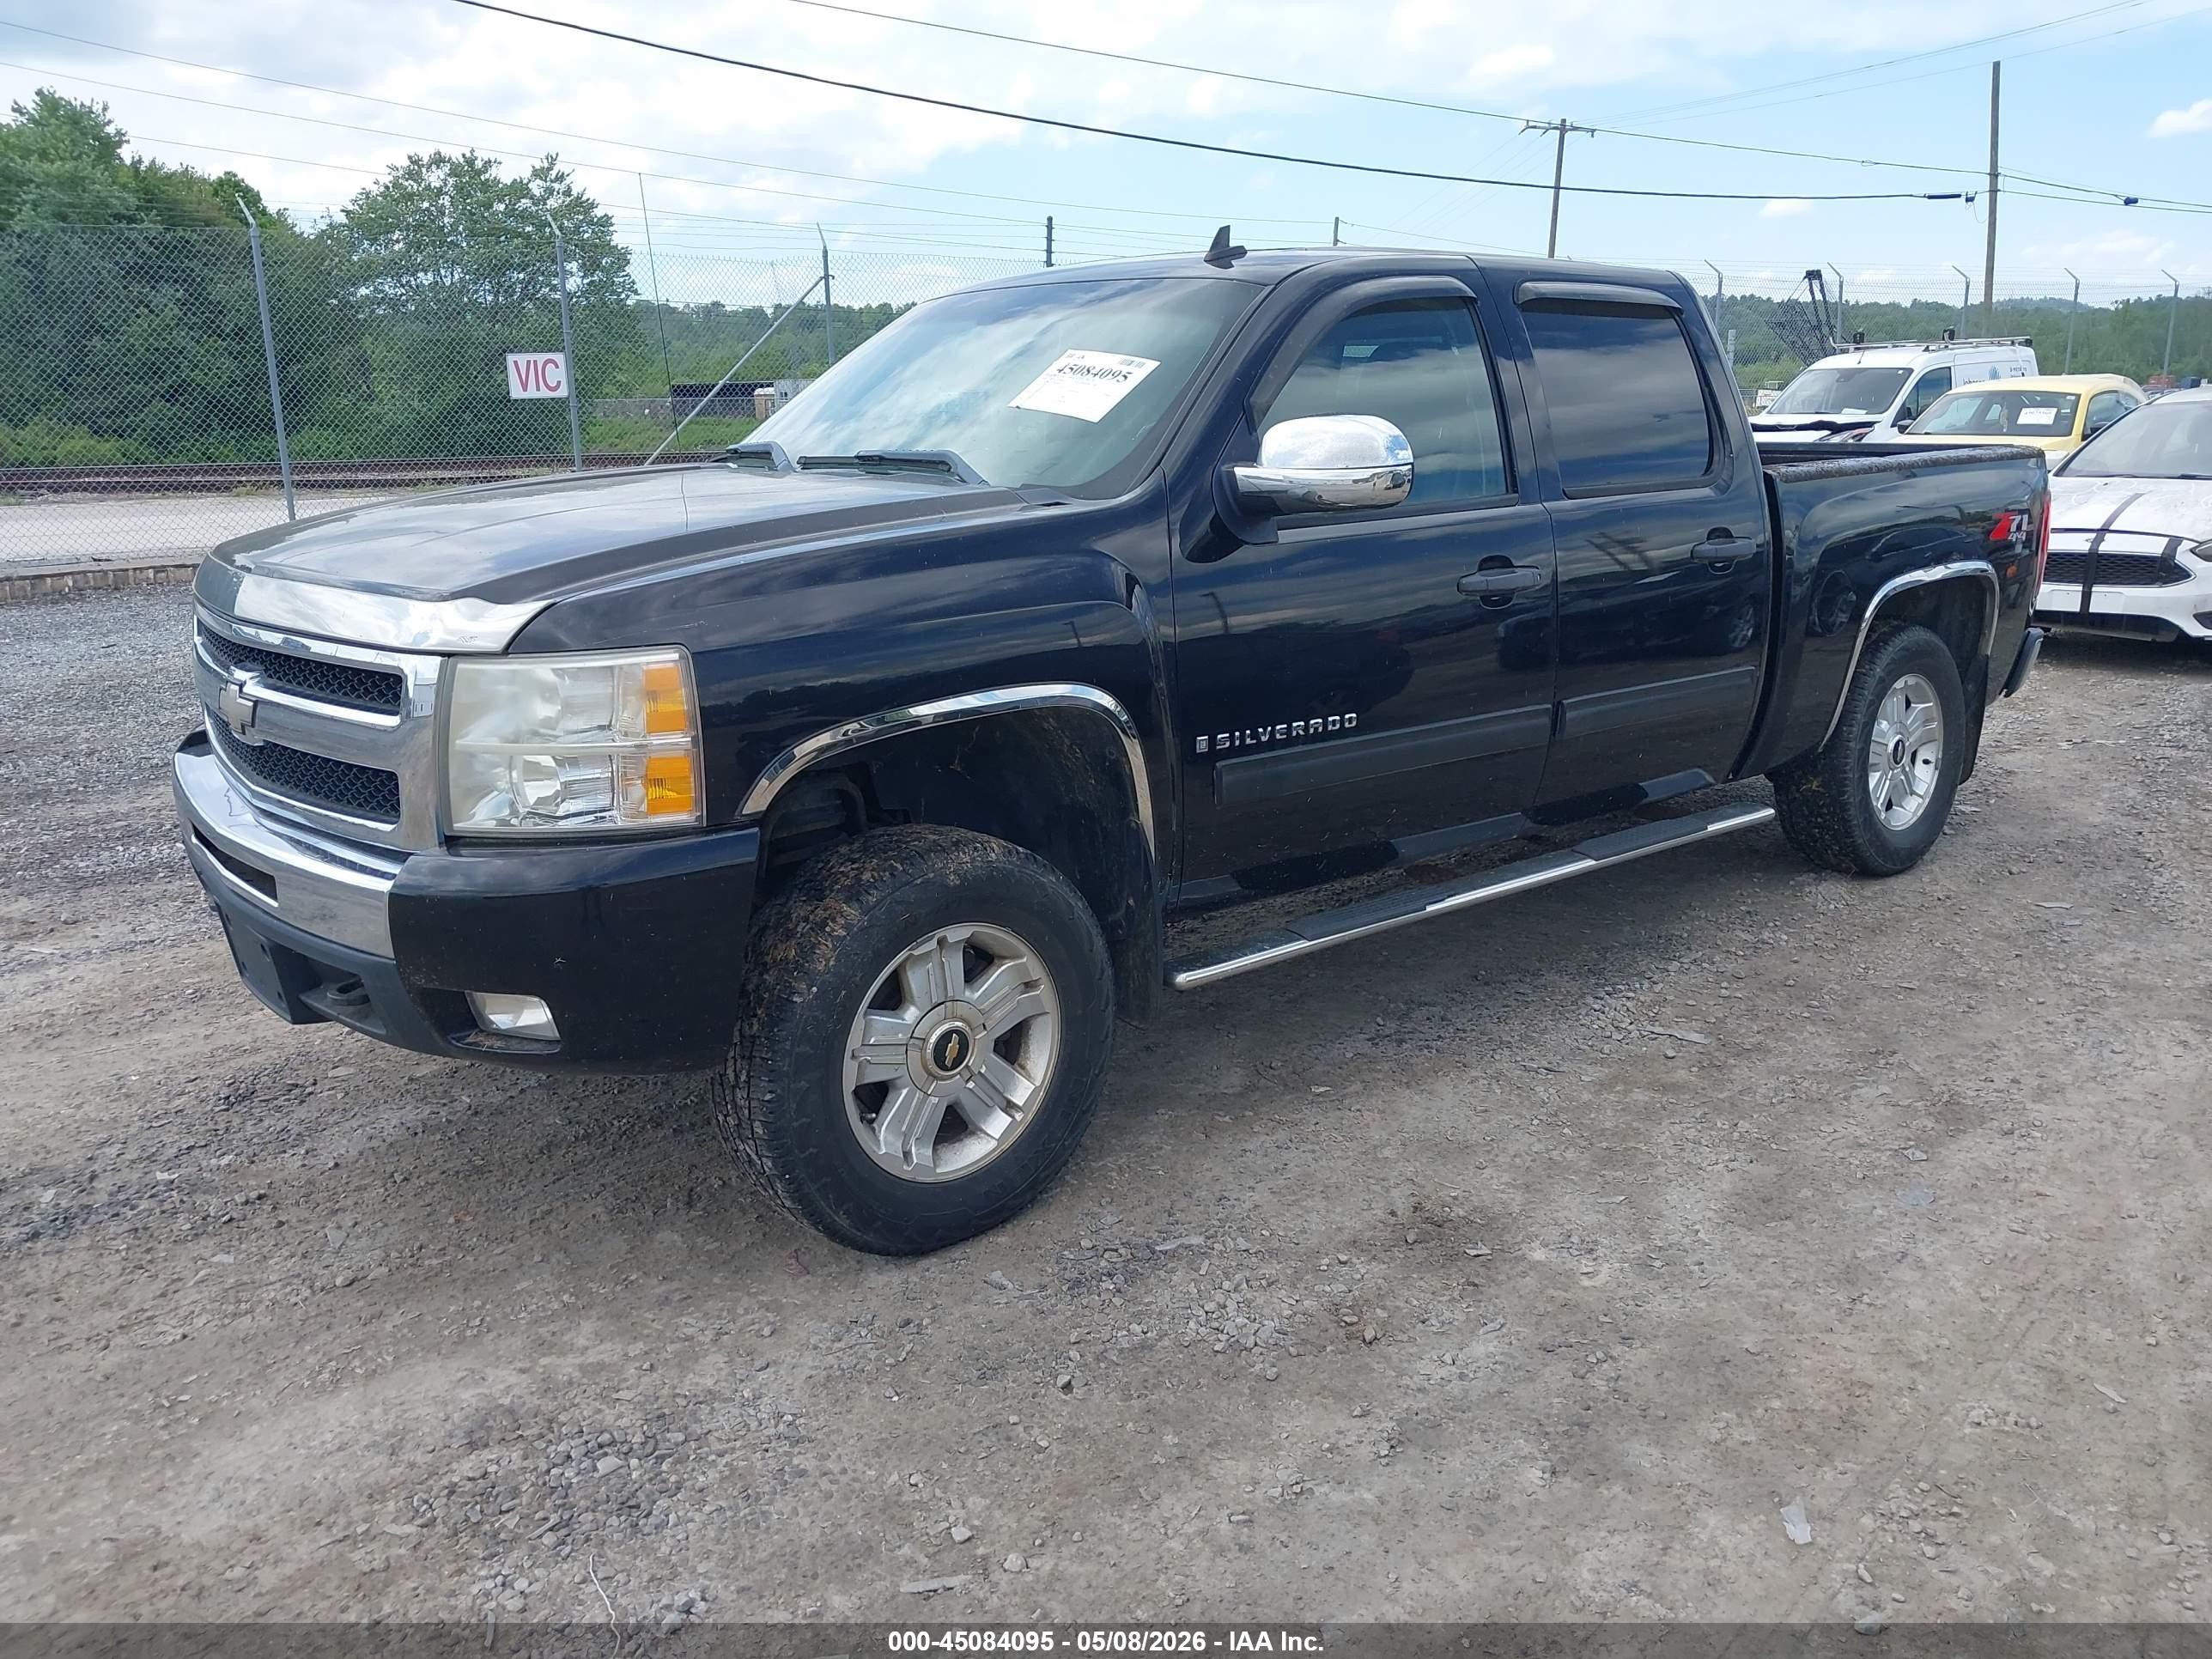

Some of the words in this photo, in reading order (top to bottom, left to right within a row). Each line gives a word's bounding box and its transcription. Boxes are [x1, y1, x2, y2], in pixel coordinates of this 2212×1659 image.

[513, 358, 562, 392] VIC
[1056, 362, 1133, 383] 45084095
[1216, 712, 1358, 750] SILVERADO
